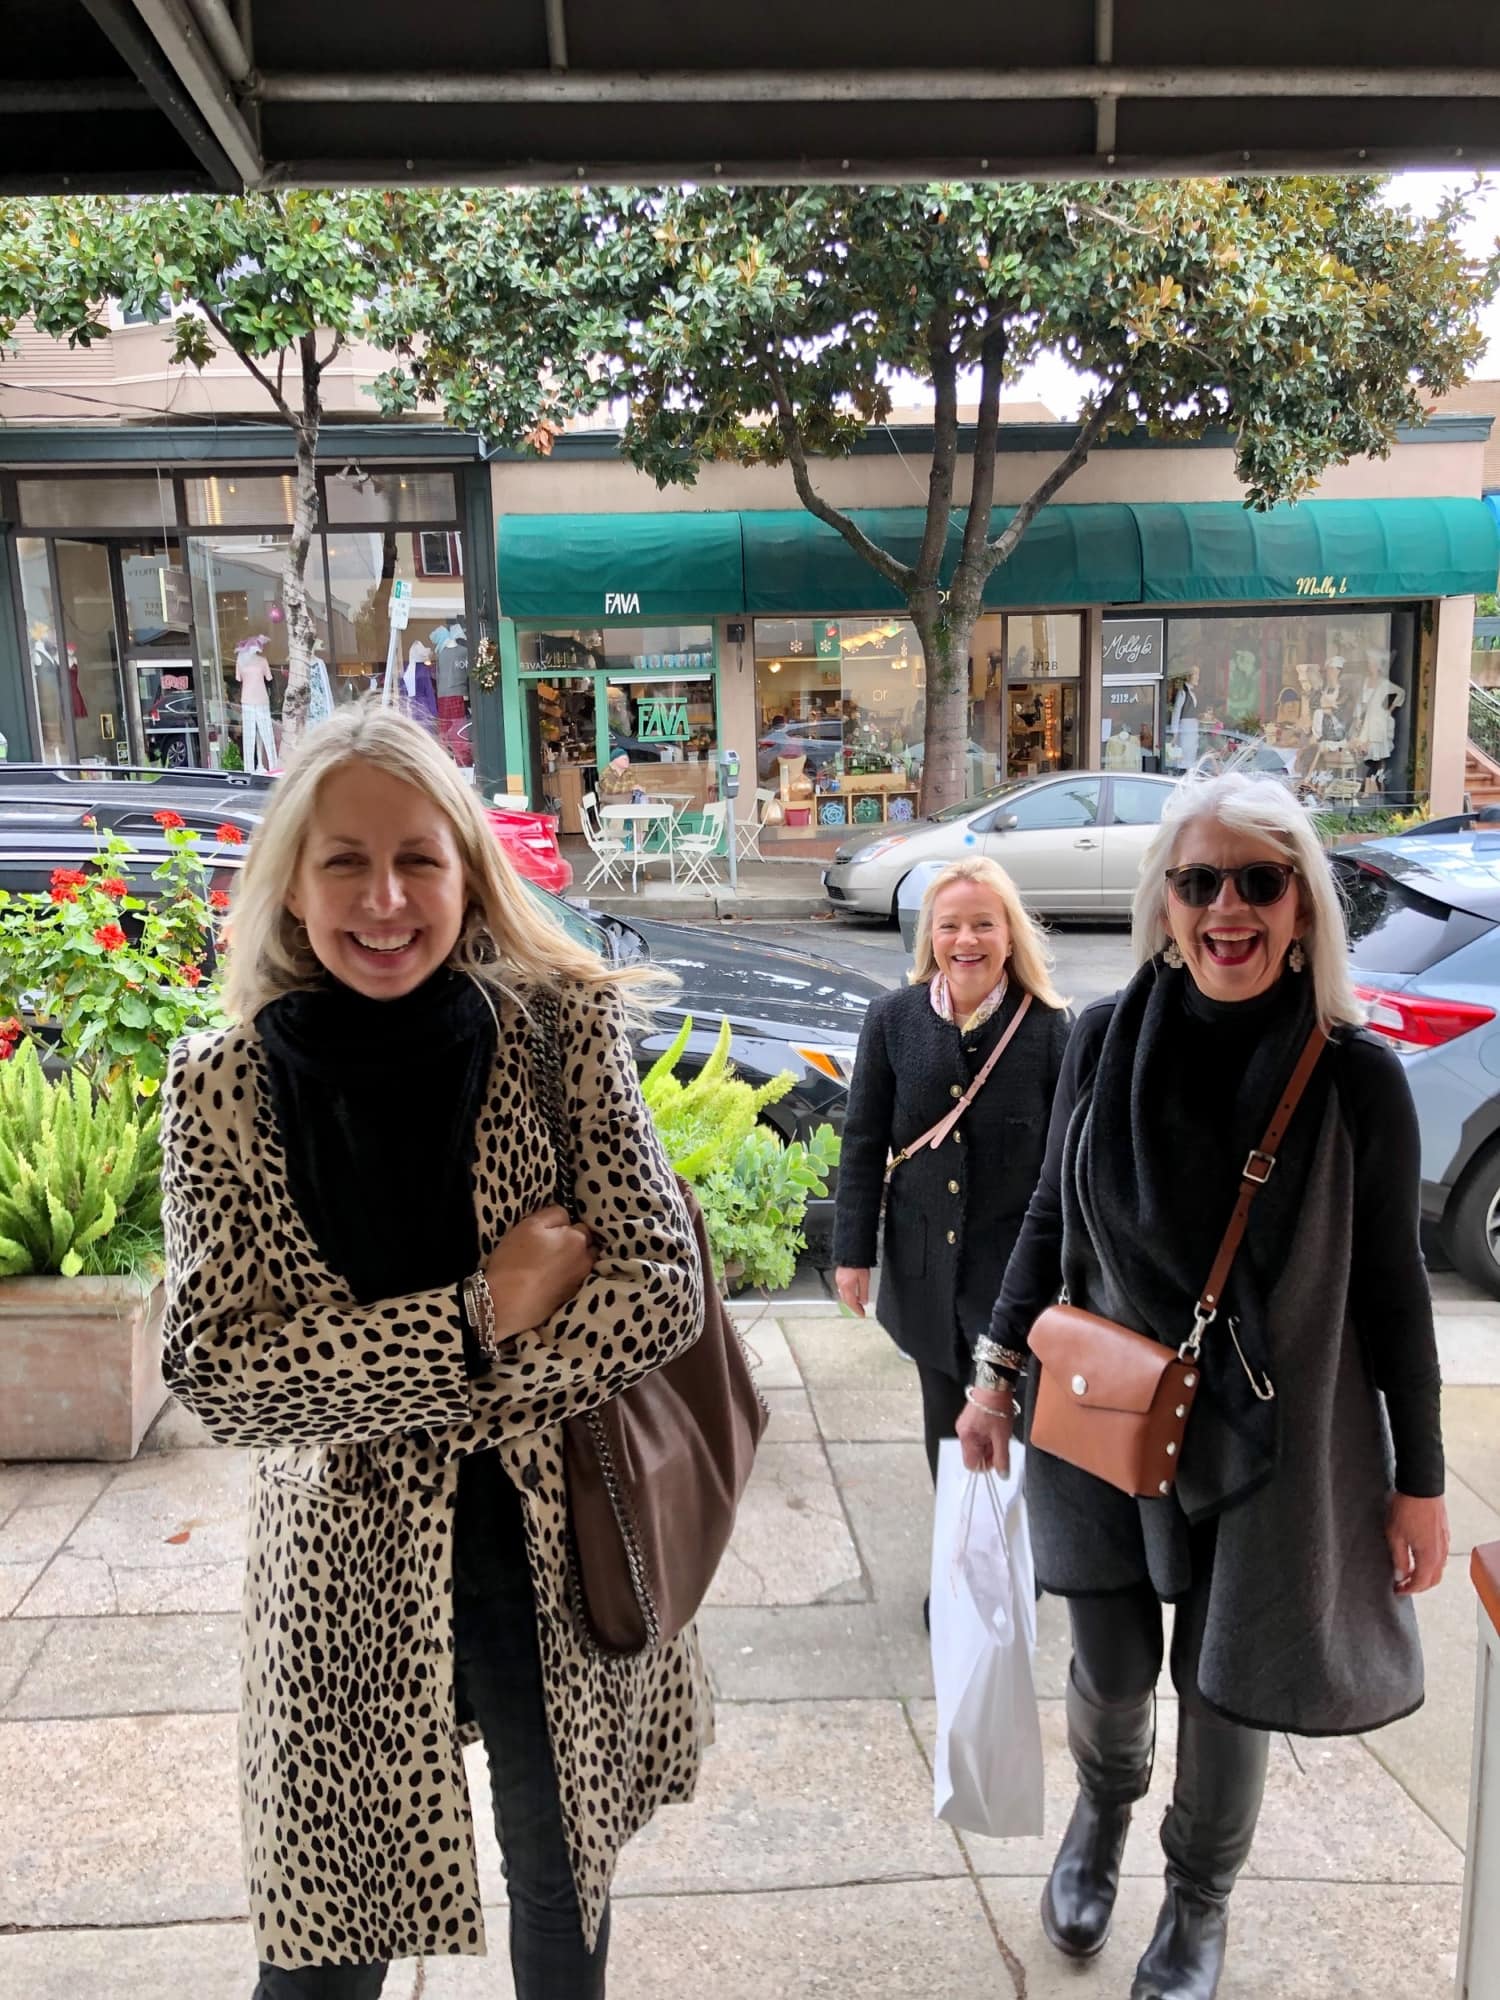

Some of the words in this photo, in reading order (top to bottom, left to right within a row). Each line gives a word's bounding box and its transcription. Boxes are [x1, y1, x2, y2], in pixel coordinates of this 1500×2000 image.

[1296, 576, 1336, 598] Molly
[1339, 577, 1347, 593] b
[605, 592, 640, 614] FAVA
[1103, 633, 1141, 662] Molly
[638, 703, 689, 736] FAVA
